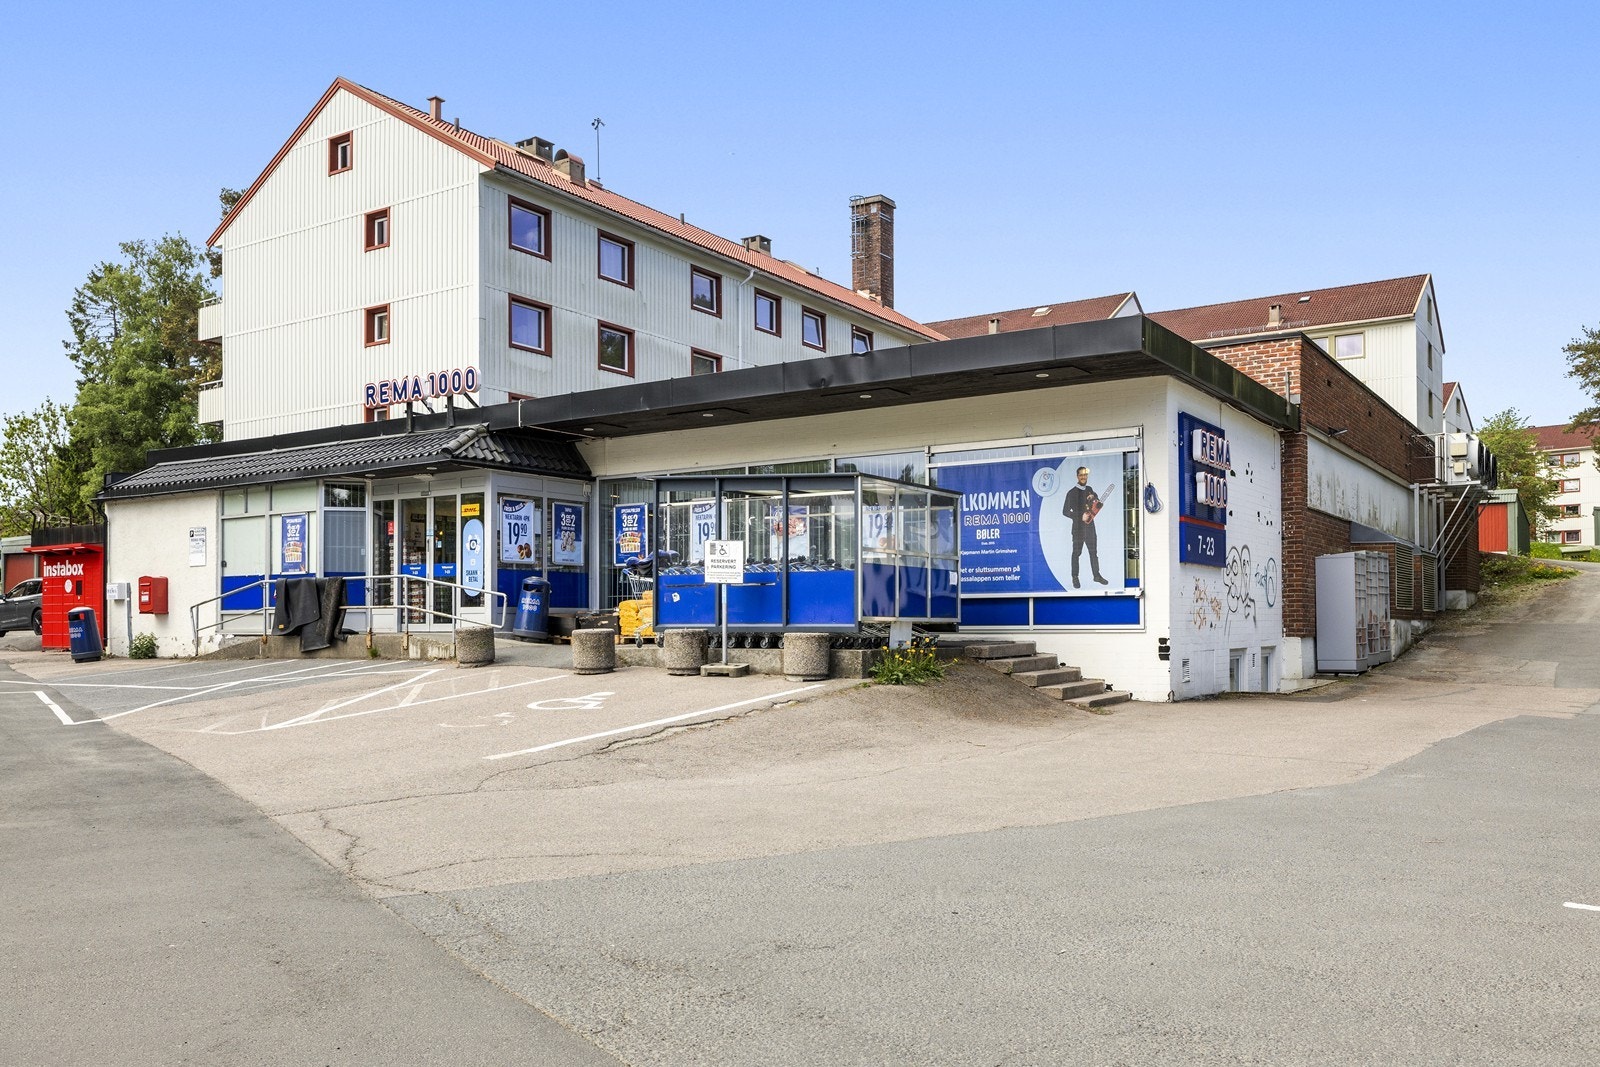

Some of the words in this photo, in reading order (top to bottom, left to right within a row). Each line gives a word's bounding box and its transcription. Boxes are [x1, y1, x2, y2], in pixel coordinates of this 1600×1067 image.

[365, 375, 423, 407] REMA
[427, 366, 478, 398] 1000
[1200, 429, 1231, 470] REMA
[960, 489, 1031, 512] LKOMMEN
[1203, 472, 1228, 508] 1000
[561, 514, 566, 526] 3
[571, 514, 576, 526] 2
[622, 516, 627, 527] 3
[633, 514, 638, 526] 2
[868, 514, 883, 538] 19
[964, 514, 1000, 526] REMA
[1003, 512, 1031, 524] 1000
[508, 522, 520, 545] 19
[521, 524, 527, 534] 90
[698, 522, 709, 545] 19
[976, 528, 1000, 540] BØLER
[1198, 535, 1215, 556] 7-23
[44, 560, 84, 576] instabox
